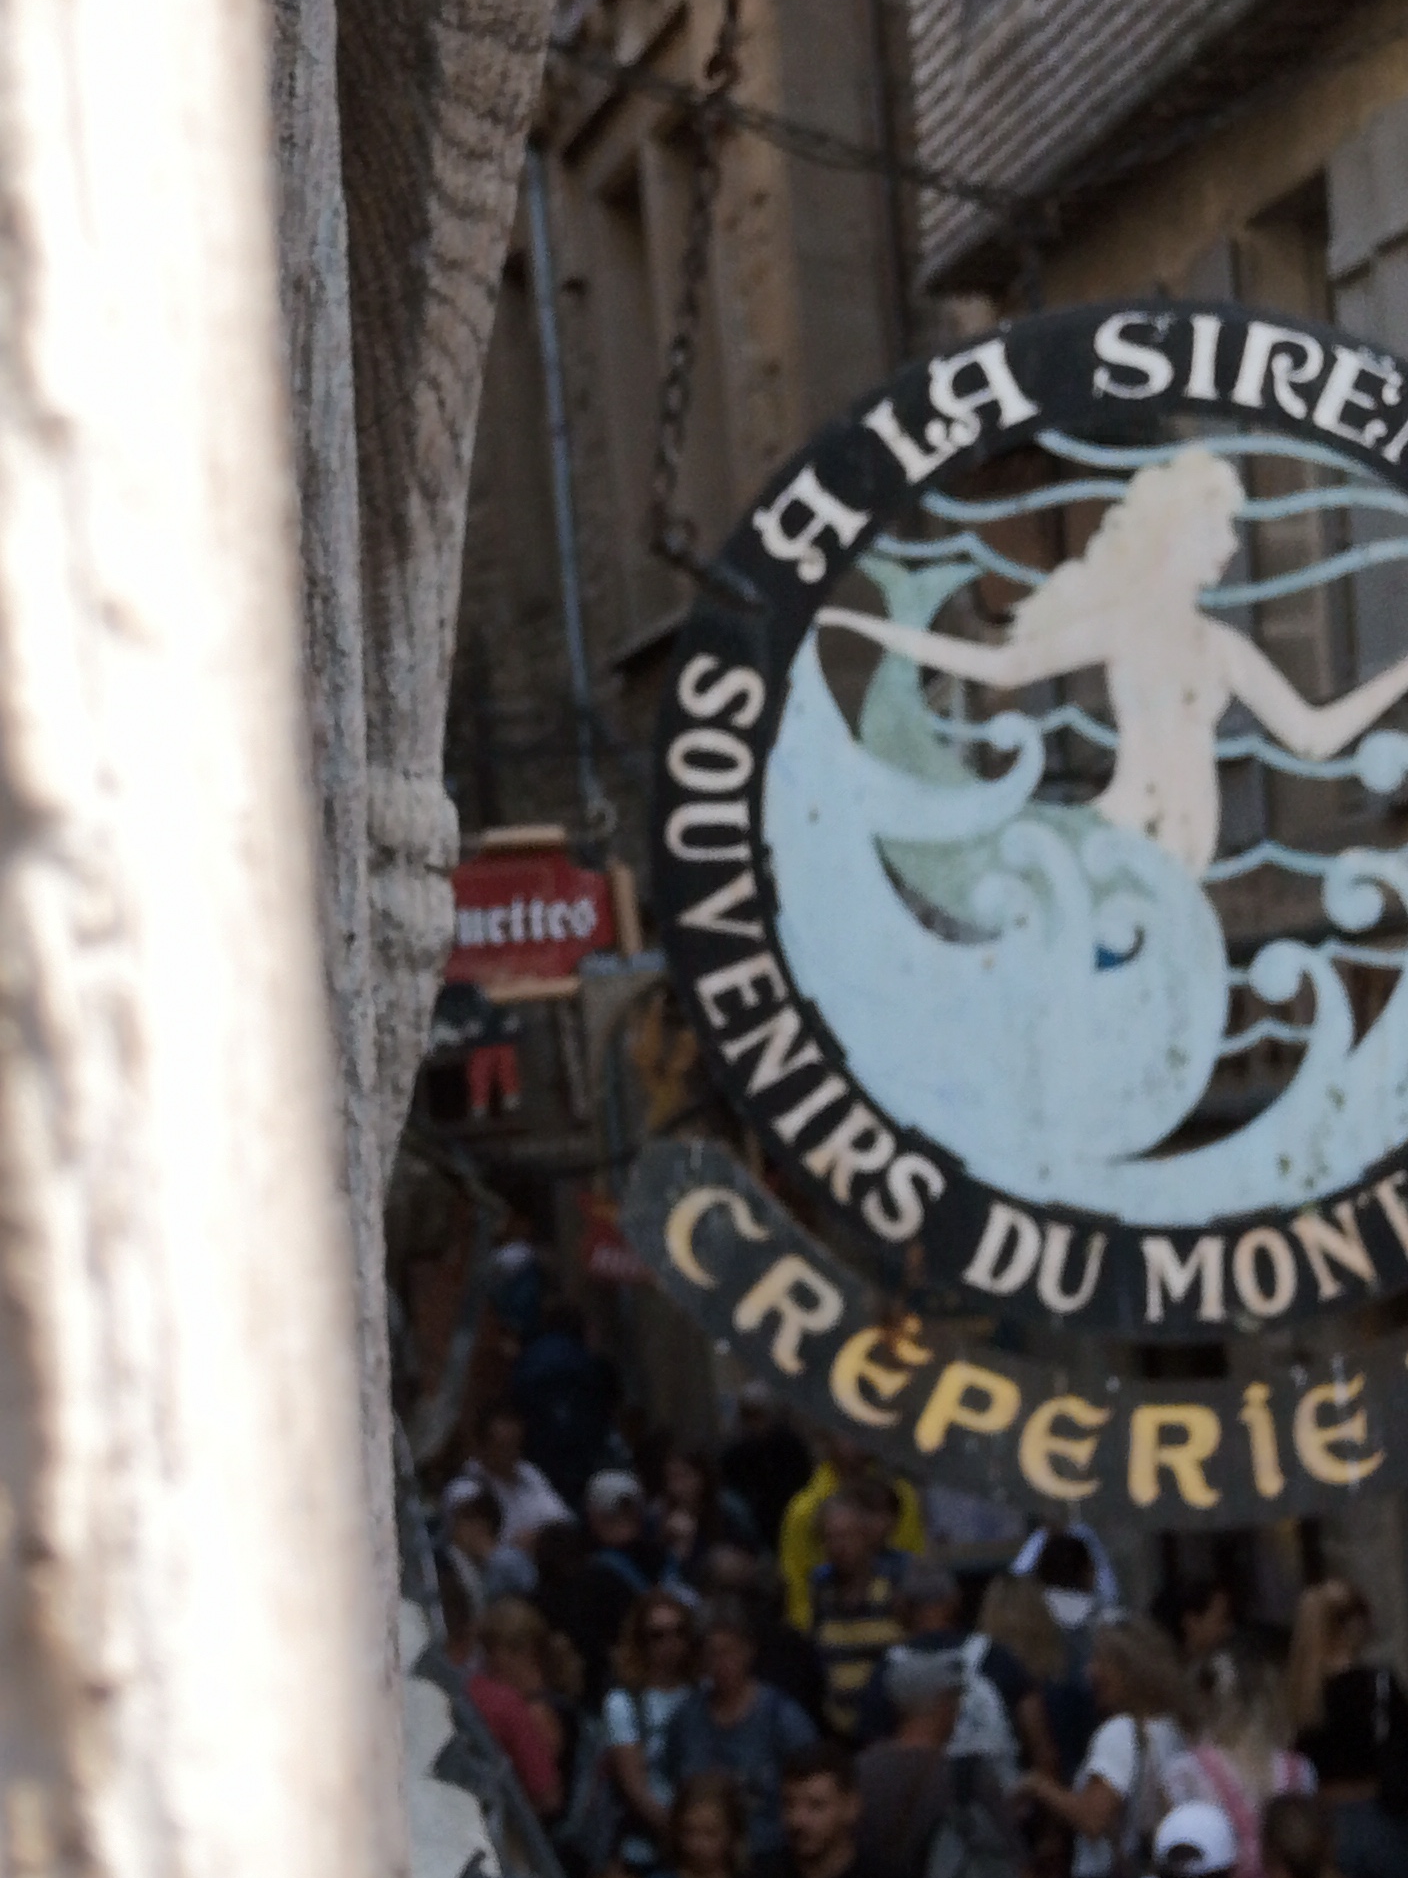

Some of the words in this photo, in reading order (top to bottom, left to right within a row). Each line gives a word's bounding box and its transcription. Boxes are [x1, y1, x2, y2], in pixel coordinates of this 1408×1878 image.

[752, 463, 871, 584] A
[862, 337, 1041, 485] LA
[664, 652, 946, 1242] SOUVENIRS
[964, 1202, 1109, 1313] DU
